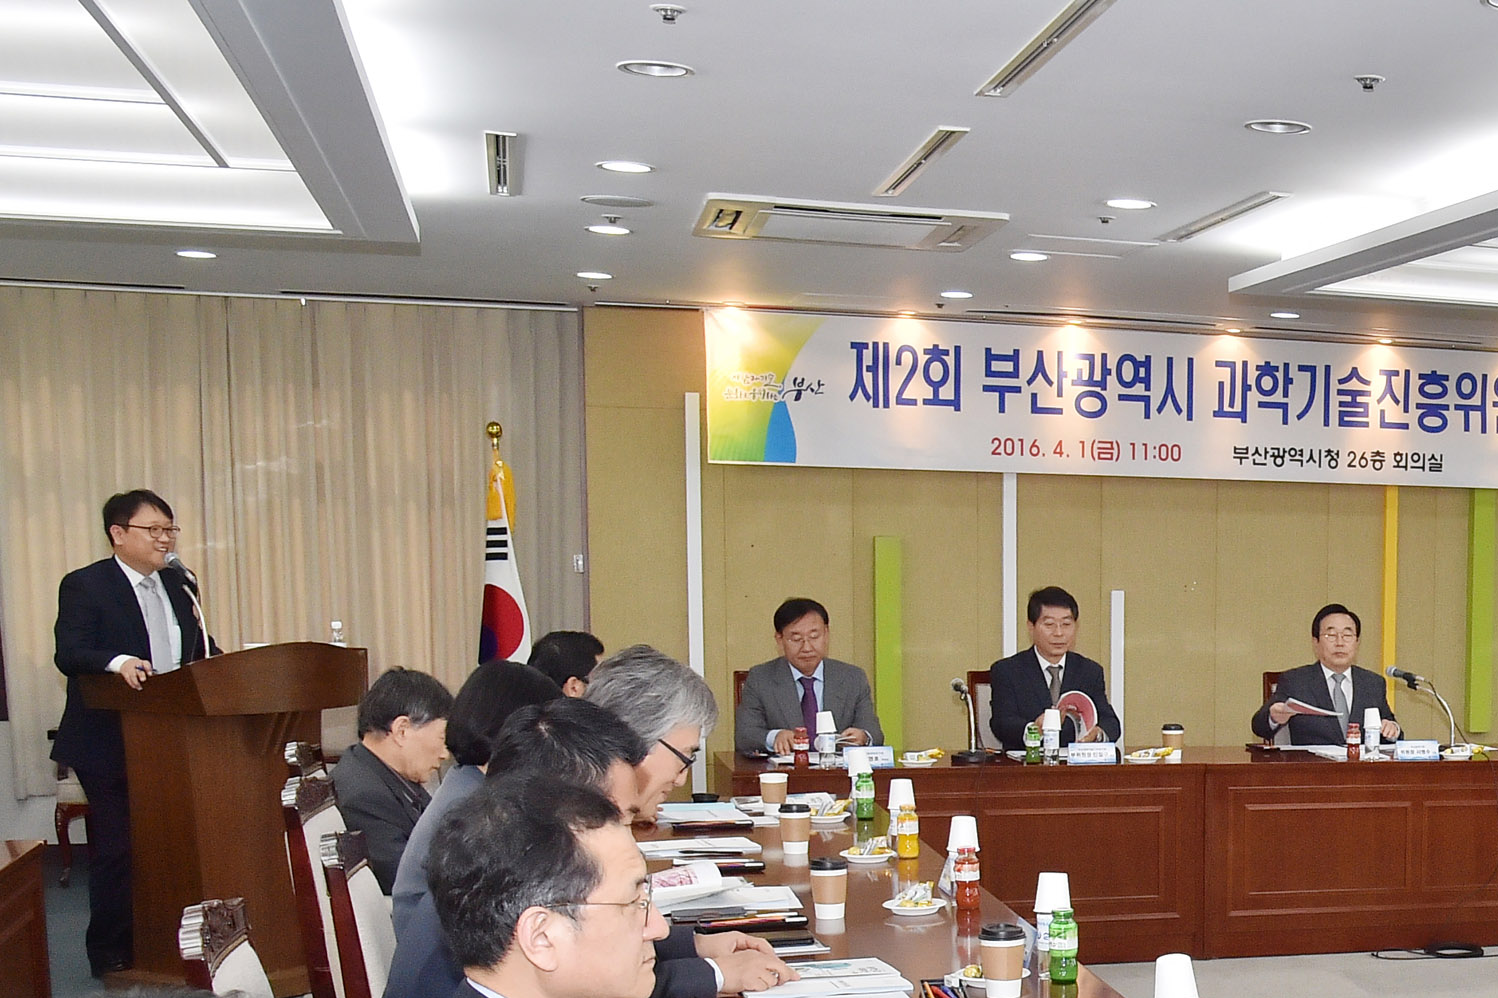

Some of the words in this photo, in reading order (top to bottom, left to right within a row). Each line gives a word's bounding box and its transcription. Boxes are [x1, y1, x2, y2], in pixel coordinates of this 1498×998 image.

[782, 376, 825, 402] 부산
[849, 341, 962, 412] 제2회
[982, 347, 1194, 422] 부산광역시
[1129, 442, 1182, 463] 11:00
[1233, 446, 1340, 470] 부산광역시청
[1347, 451, 1386, 471] 26층
[1392, 453, 1443, 473] 회의실
